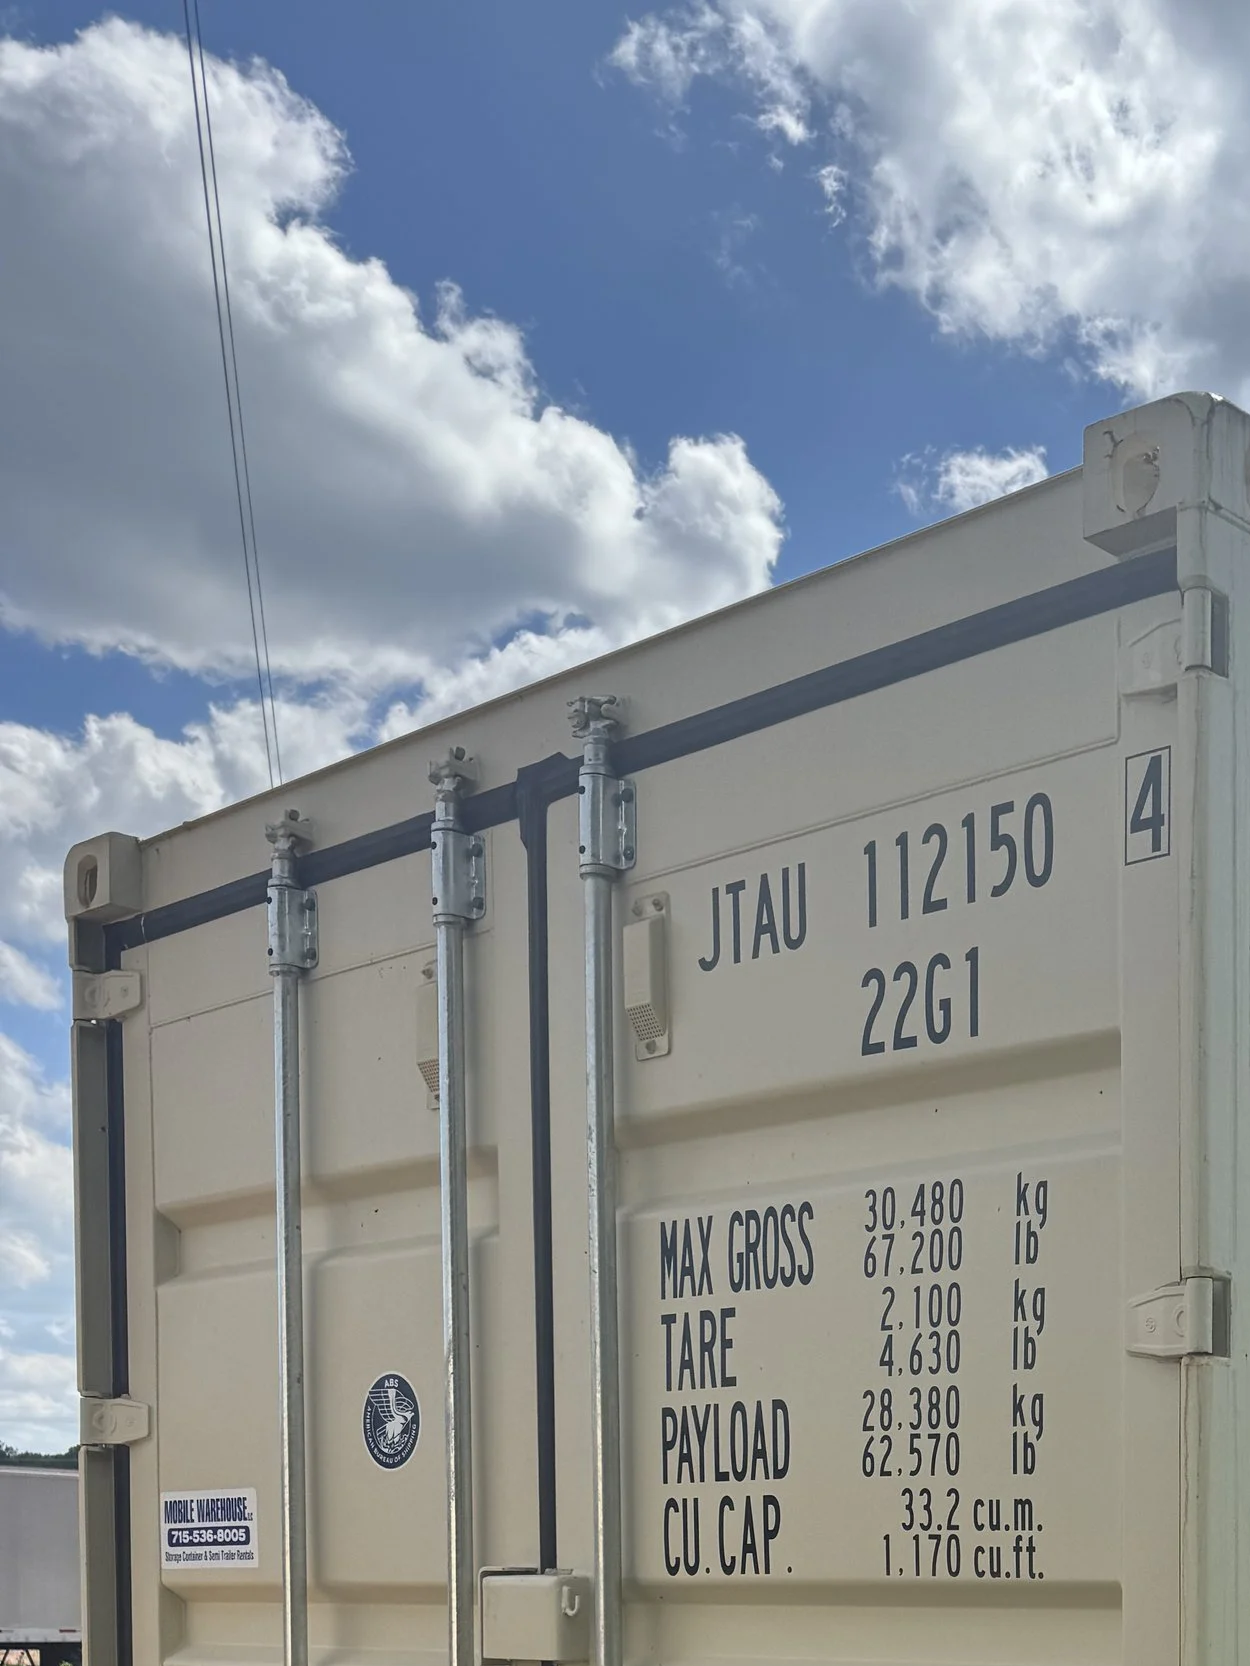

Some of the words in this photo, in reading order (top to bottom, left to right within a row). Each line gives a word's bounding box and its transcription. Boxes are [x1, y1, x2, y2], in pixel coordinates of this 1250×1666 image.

[698, 862, 807, 972] JTAU
[862, 792, 1054, 928] 112150
[1130, 754, 1165, 853] 4
[861, 946, 980, 1056] 22G1
[660, 1214, 714, 1300] MAX
[728, 1201, 814, 1293] GROSS
[864, 1178, 964, 1233] 30,480
[1016, 1172, 1049, 1229] kg
[863, 1226, 963, 1278] 67,200
[1014, 1220, 1039, 1265] lb
[661, 1307, 738, 1392] TARE
[880, 1282, 962, 1332] 2,100
[1012, 1278, 1047, 1335] kg
[879, 1329, 961, 1378] 4,630
[1012, 1326, 1037, 1371] lb
[384, 1378, 399, 1388] ABS
[662, 1399, 790, 1485] PAYLOAD
[862, 1385, 960, 1433] 28,380
[1011, 1382, 1044, 1441] kg
[861, 1431, 960, 1478] 62,570
[1012, 1432, 1036, 1475] lb
[164, 1499, 194, 1524] MOBILE
[196, 1497, 247, 1523] WAREHOUSE
[901, 1488, 960, 1532] 33.2
[973, 1498, 1043, 1533] cu.m.
[165, 1551, 181, 1563] Storage
[182, 1551, 203, 1561] Container
[208, 1550, 220, 1561] Semi
[221, 1549, 236, 1561] Trailer
[882, 1534, 961, 1578] 1,170
[973, 1536, 1044, 1579] cu.ft.
